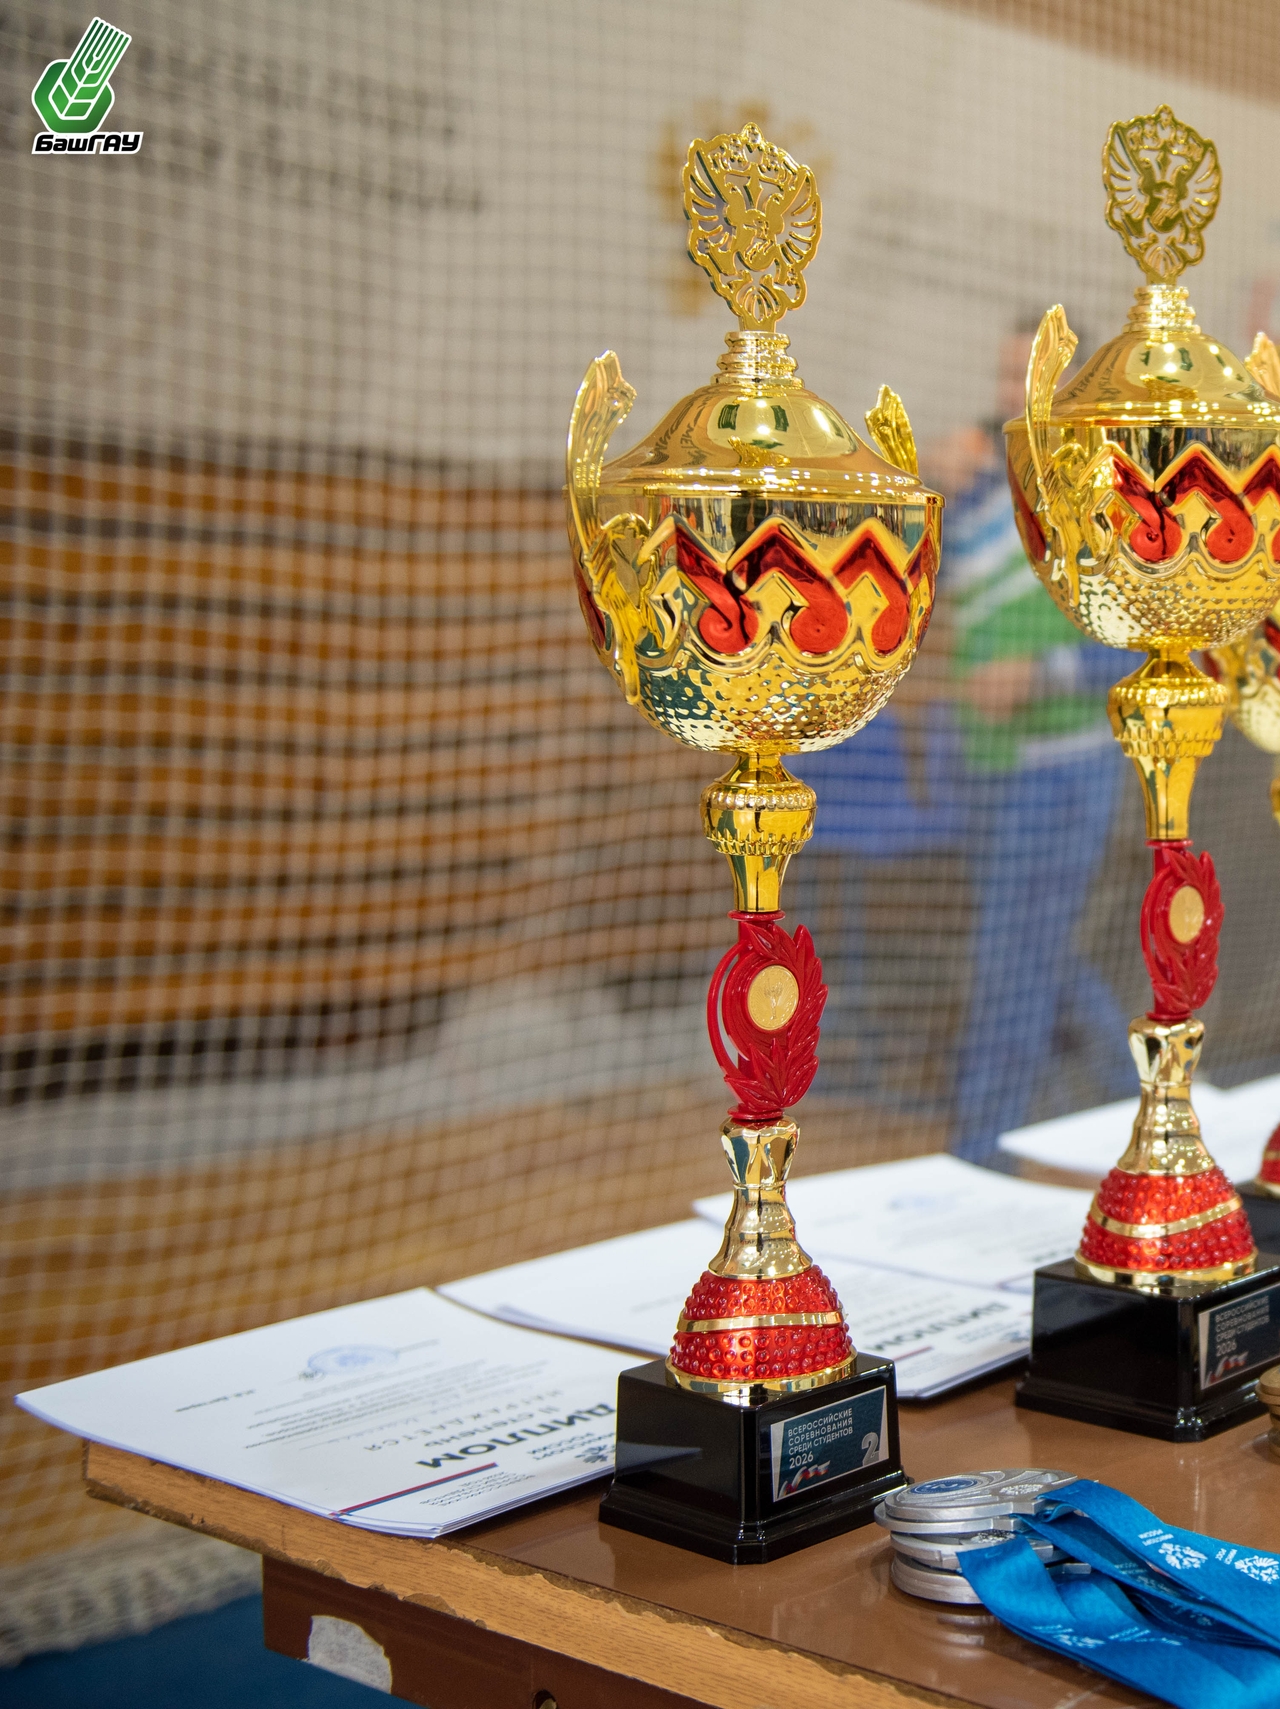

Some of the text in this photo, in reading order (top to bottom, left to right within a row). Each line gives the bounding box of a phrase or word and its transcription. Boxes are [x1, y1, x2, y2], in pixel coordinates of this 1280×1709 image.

[414, 1402, 617, 1469] ДИПЛОМ
[787, 1407, 853, 1437] ВСЕРОССИЙСКИЕ
[788, 1417, 853, 1447] СОРЕВНОВАНИЯ
[788, 1426, 854, 1456] СРЕДИ СТУДЕНТОВ
[789, 1451, 814, 1469] 2026
